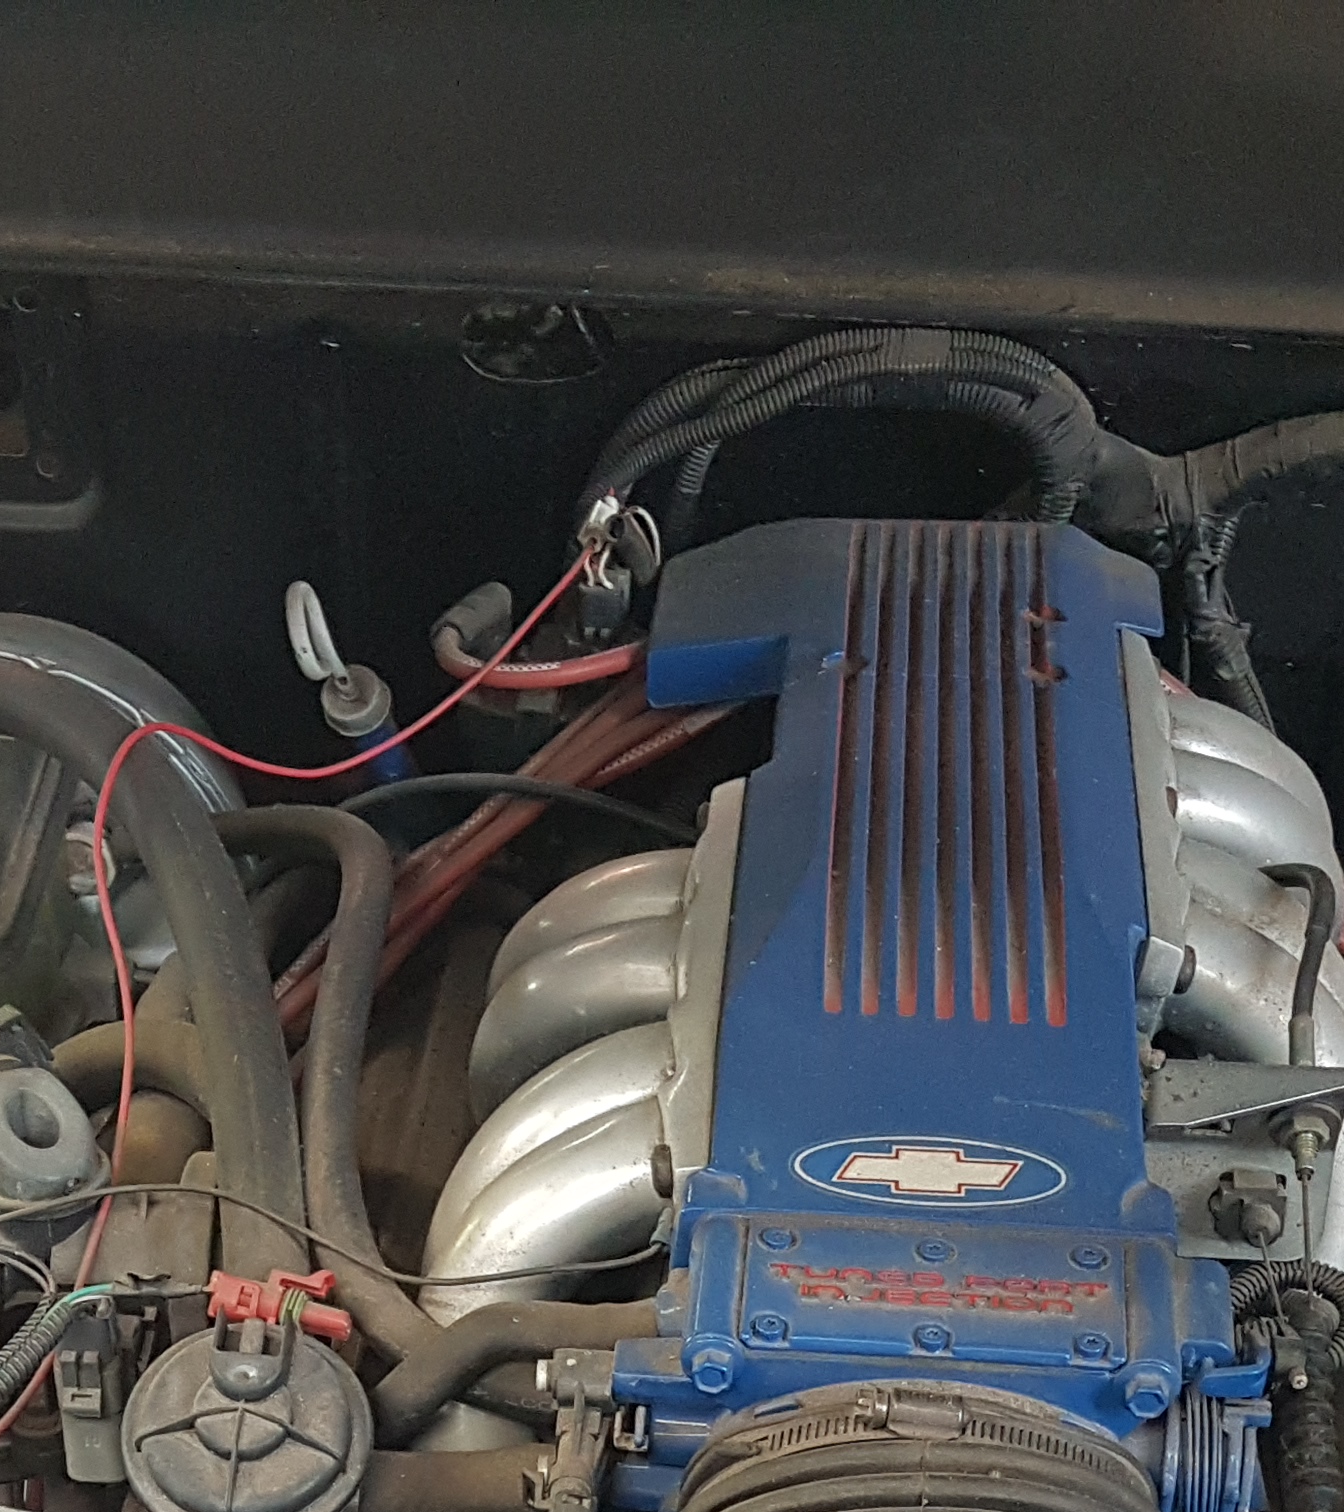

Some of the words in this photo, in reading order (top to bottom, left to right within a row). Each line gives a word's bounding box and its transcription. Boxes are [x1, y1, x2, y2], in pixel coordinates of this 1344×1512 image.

[768, 1262, 945, 1288] TUNED
[964, 1274, 1109, 1298] PORT
[800, 1284, 1075, 1313] INJECTION
